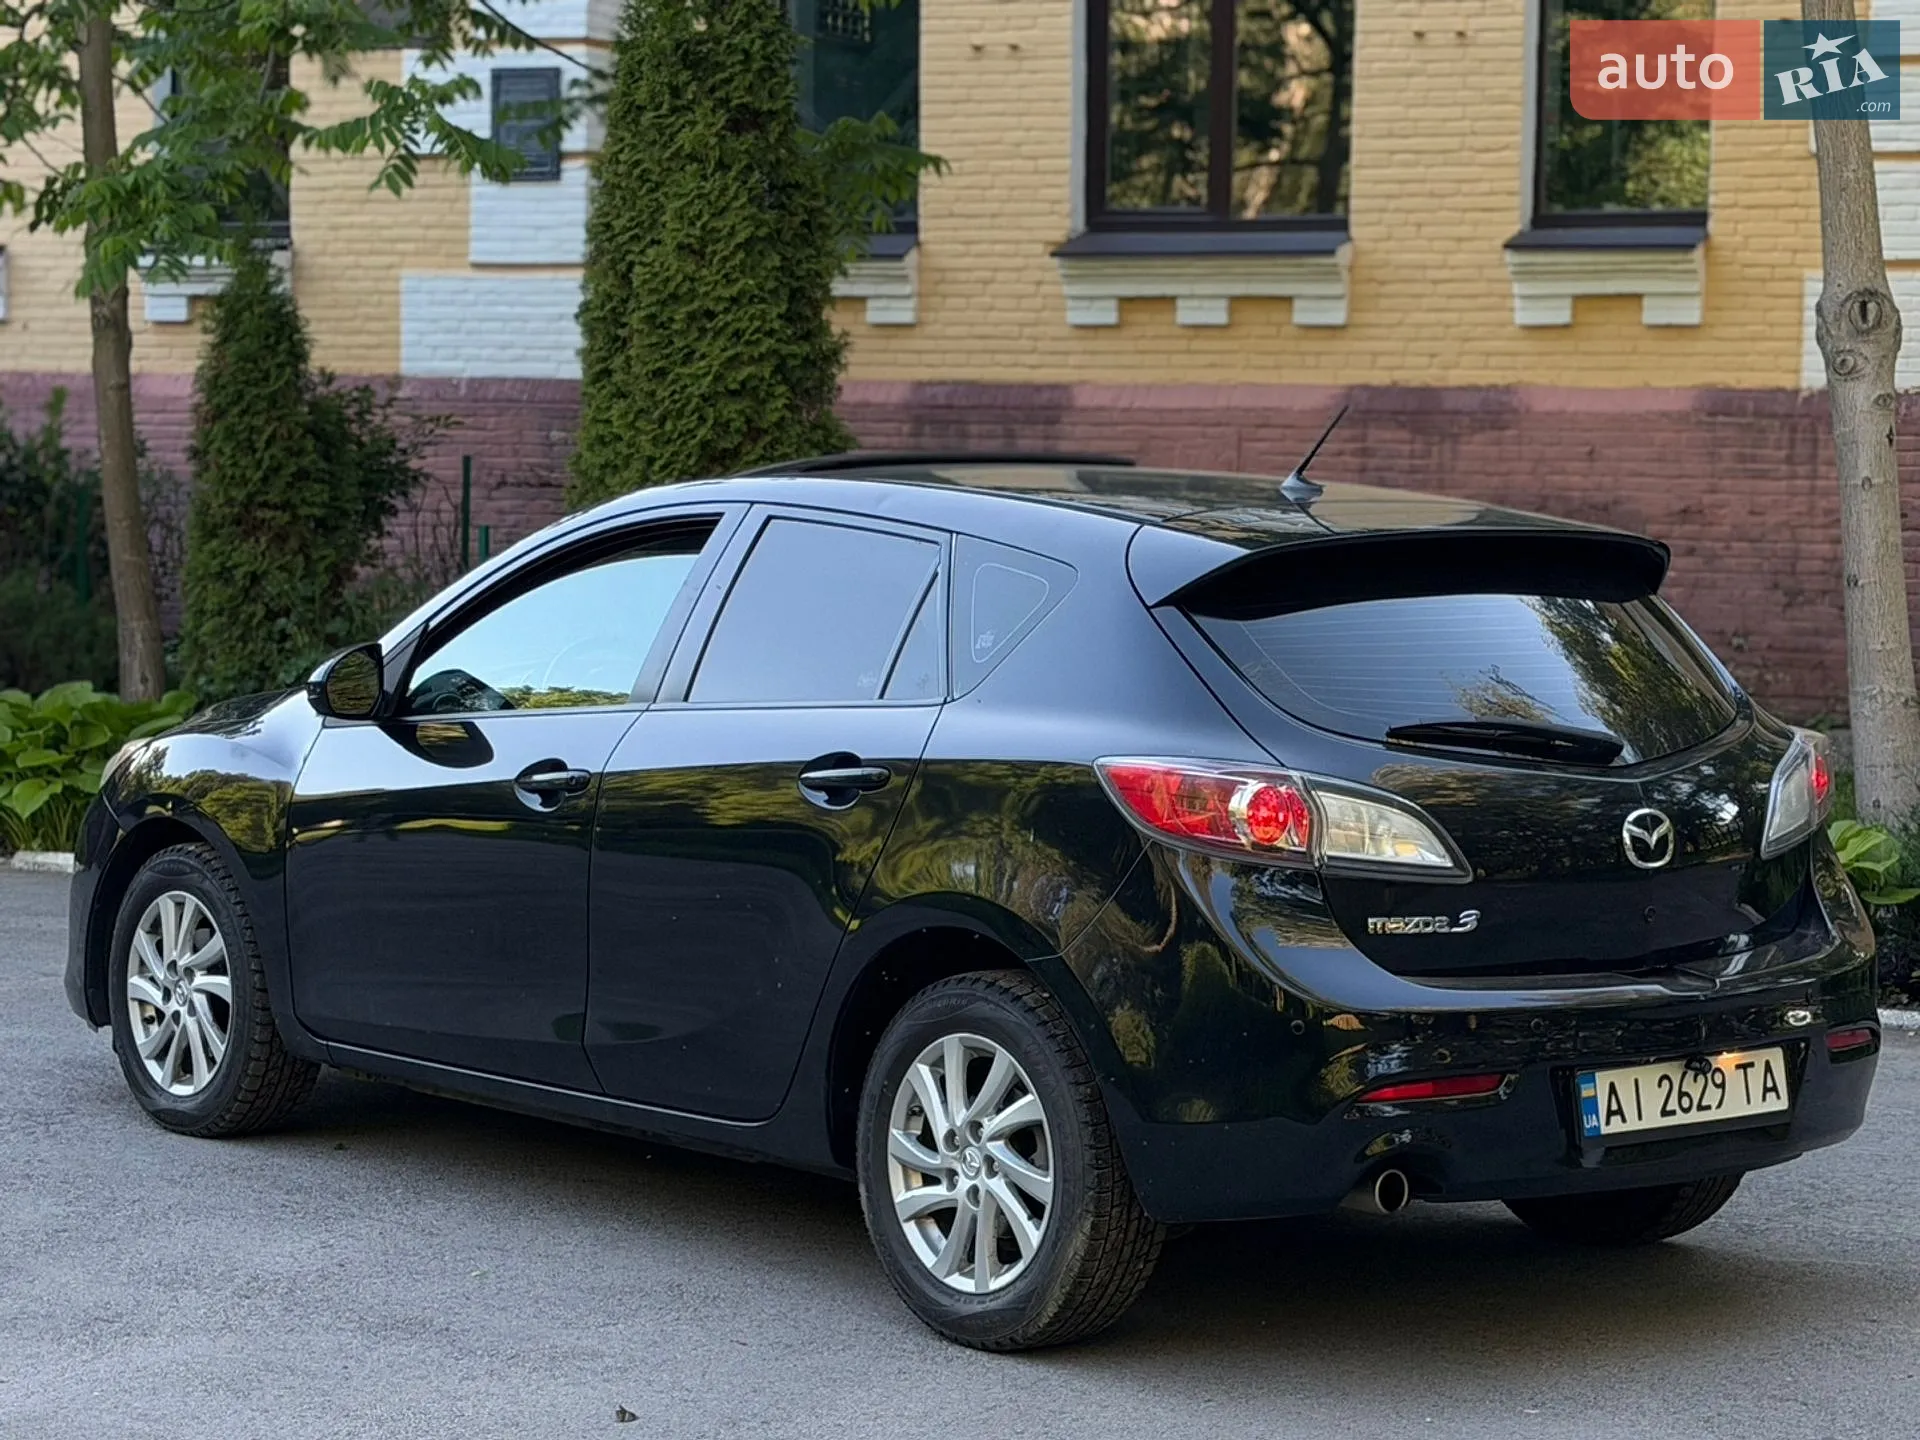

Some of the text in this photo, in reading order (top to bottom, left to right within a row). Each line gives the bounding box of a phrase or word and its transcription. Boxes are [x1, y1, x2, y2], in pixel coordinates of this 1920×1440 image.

[1657, 1067, 1727, 1118] 2629
[1734, 1059, 1782, 1105] TA
[1583, 1115, 1599, 1128] UA
